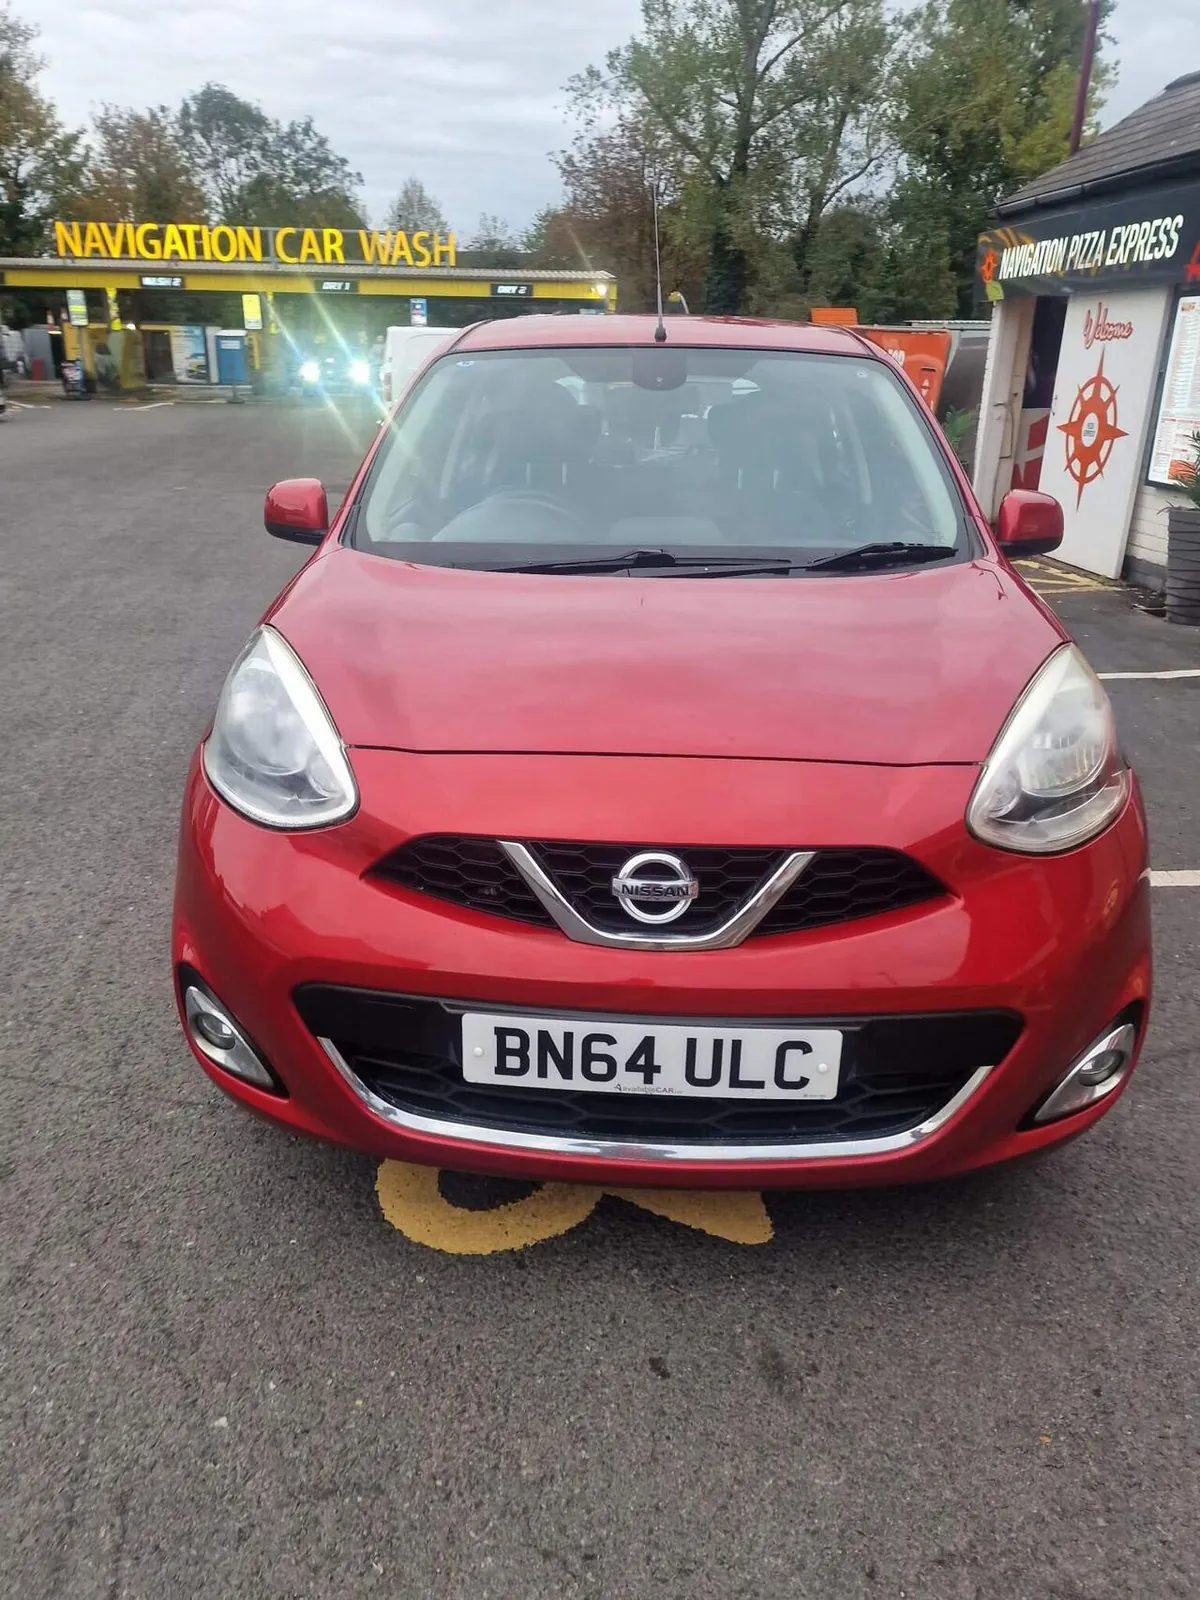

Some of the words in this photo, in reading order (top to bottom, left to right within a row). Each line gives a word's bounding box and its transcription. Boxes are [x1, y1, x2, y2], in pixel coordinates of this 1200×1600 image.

[54, 220, 262, 262] NAVIGATION
[275, 227, 345, 264] CAR
[359, 229, 457, 267] WASH
[998, 236, 1070, 281] NAVIGATION
[1065, 230, 1107, 271] PIZZA
[1105, 214, 1184, 265] EXPRESS
[517, 286, 527, 294] 2
[1083, 301, 1134, 350] Welcome
[621, 884, 689, 897] NISSAN
[494, 1026, 662, 1085] BN64
[685, 1037, 814, 1091] ULC
